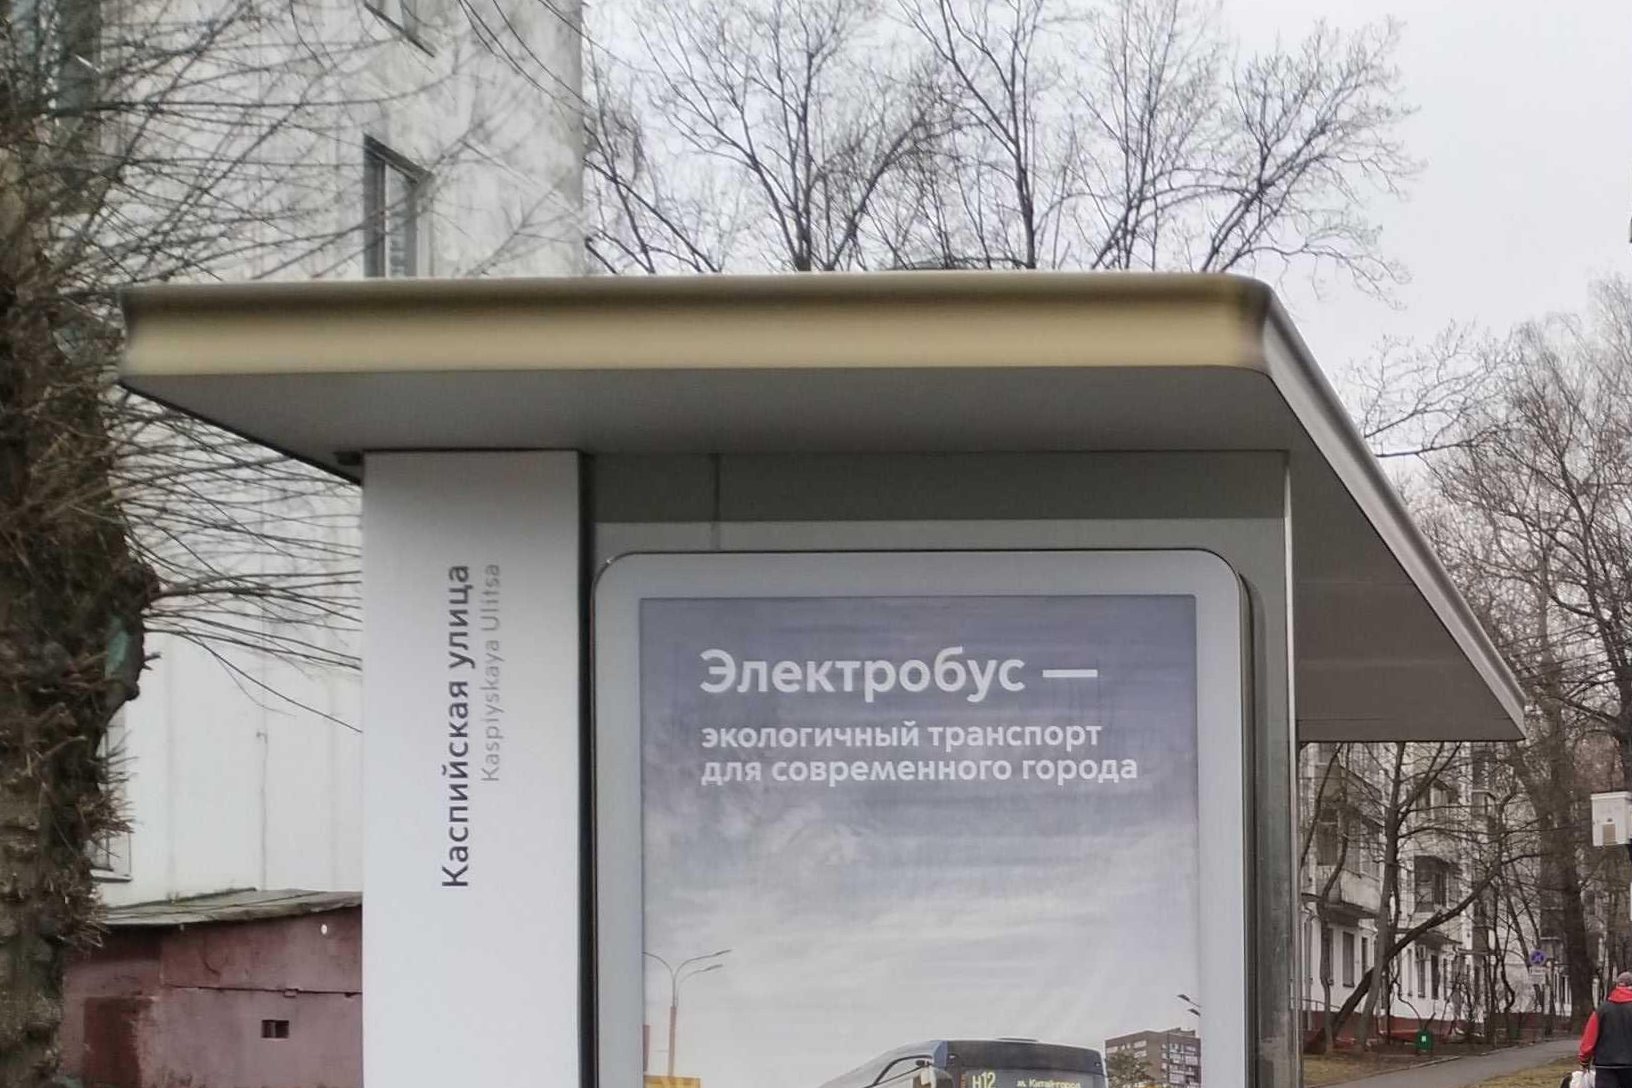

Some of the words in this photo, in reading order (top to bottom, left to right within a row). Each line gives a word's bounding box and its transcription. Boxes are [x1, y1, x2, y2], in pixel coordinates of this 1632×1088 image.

[448, 565, 475, 669] улица
[480, 564, 500, 632] Ulitsa
[699, 647, 1025, 703] Электробус
[480, 639, 505, 782] Kaspiyskaya
[701, 720, 920, 749] экологичный
[928, 723, 1103, 753] транспорт
[442, 681, 469, 887] Каспийская
[700, 759, 762, 787] для
[771, 759, 1012, 788] современного
[1023, 757, 1139, 784] города
